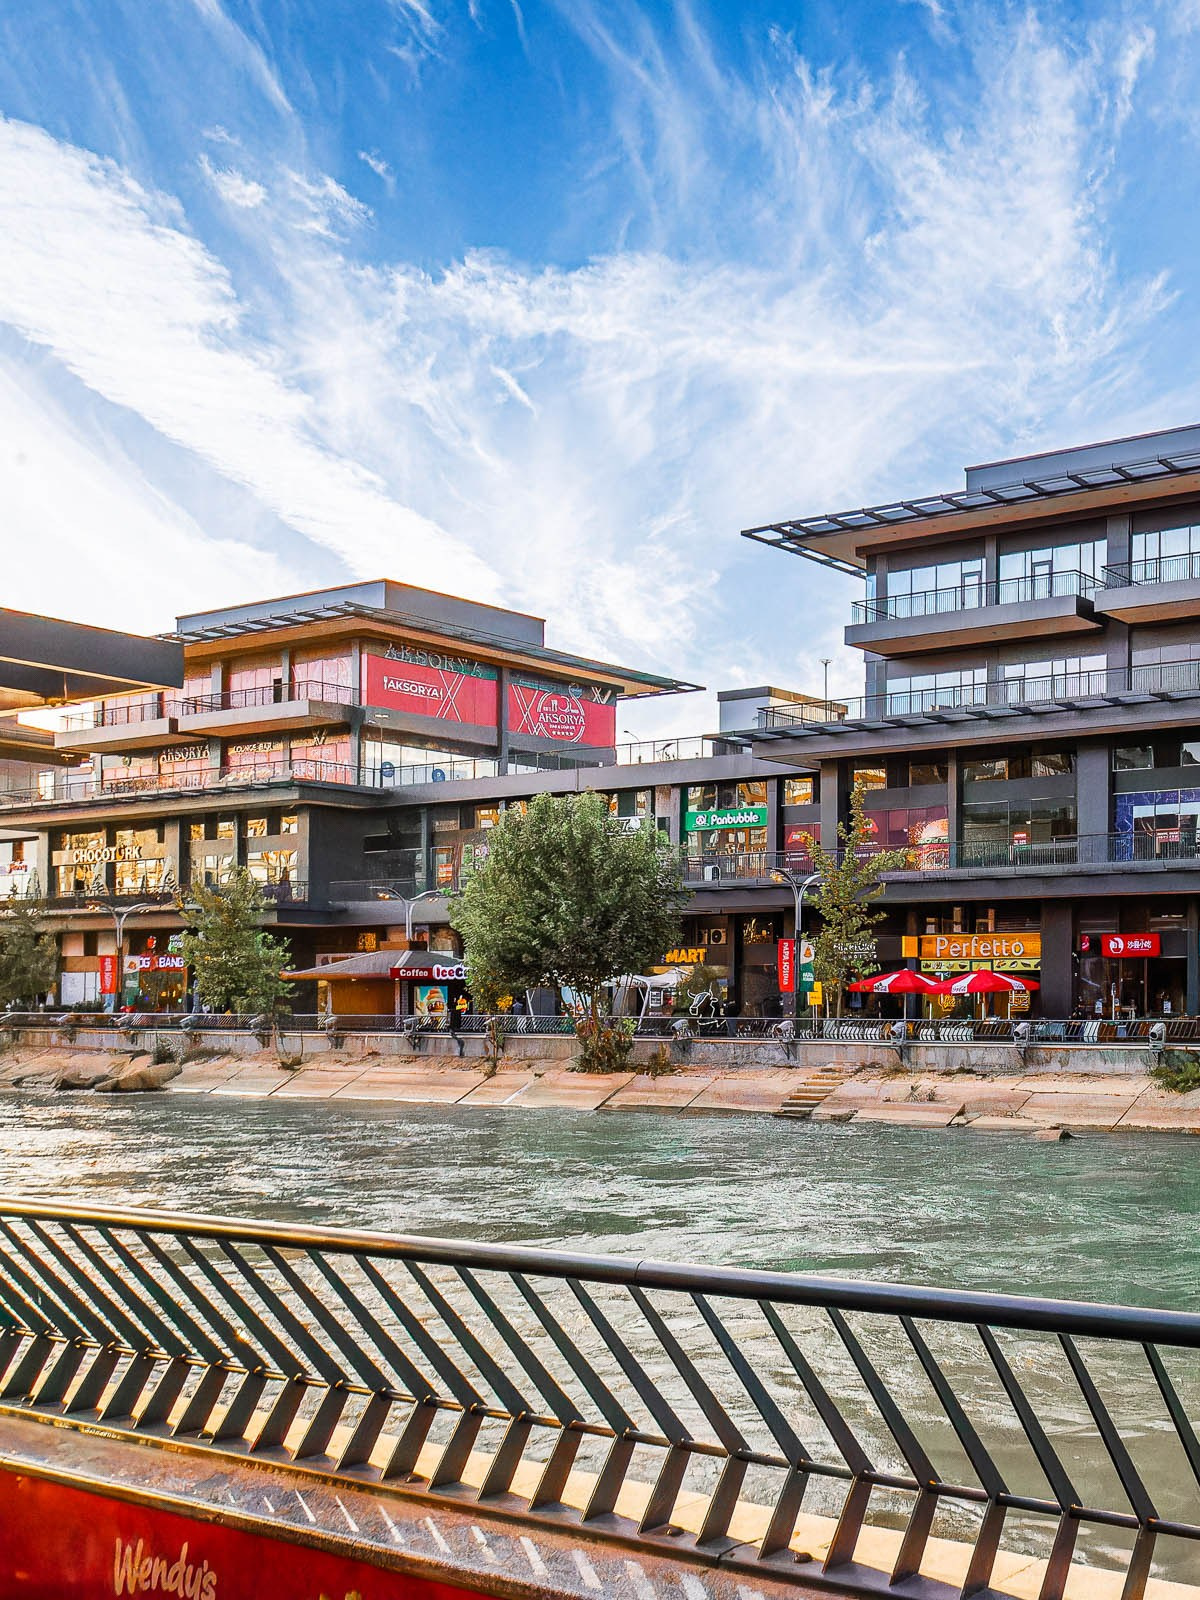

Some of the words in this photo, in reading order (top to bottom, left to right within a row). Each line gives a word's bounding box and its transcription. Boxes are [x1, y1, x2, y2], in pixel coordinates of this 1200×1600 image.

[388, 680, 440, 697] AKSORYA
[539, 713, 585, 725] AKSORYA
[711, 811, 759, 825] Panbubble
[936, 936, 1024, 957] Perfetto
[159, 957, 184, 968] BANG
[400, 968, 429, 977] Coffee
[113, 1537, 217, 1600] Wendy's
